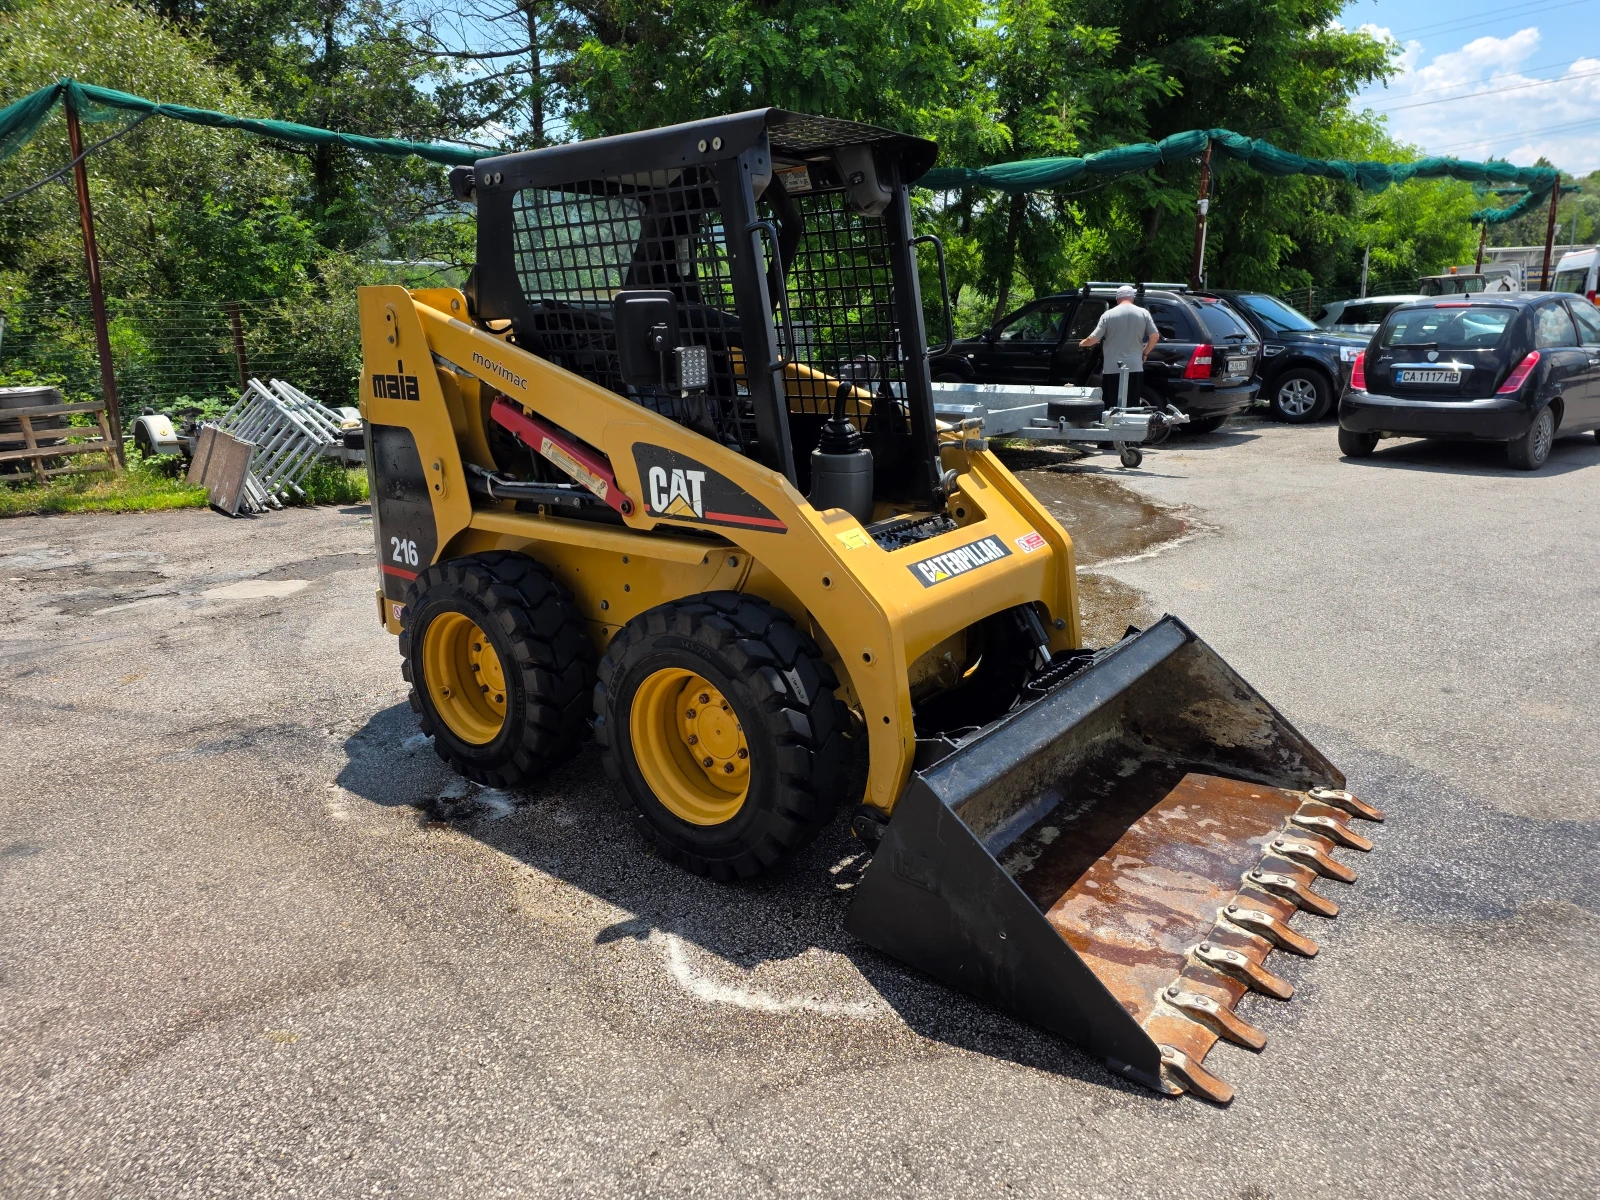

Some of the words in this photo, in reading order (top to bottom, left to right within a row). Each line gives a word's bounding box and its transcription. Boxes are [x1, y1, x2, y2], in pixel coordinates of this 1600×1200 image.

[372, 359, 420, 402] maia
[472, 351, 528, 390] movimac
[648, 465, 706, 518] CAT
[390, 536, 419, 566] 216
[917, 538, 1006, 583] CATERPILLAR
